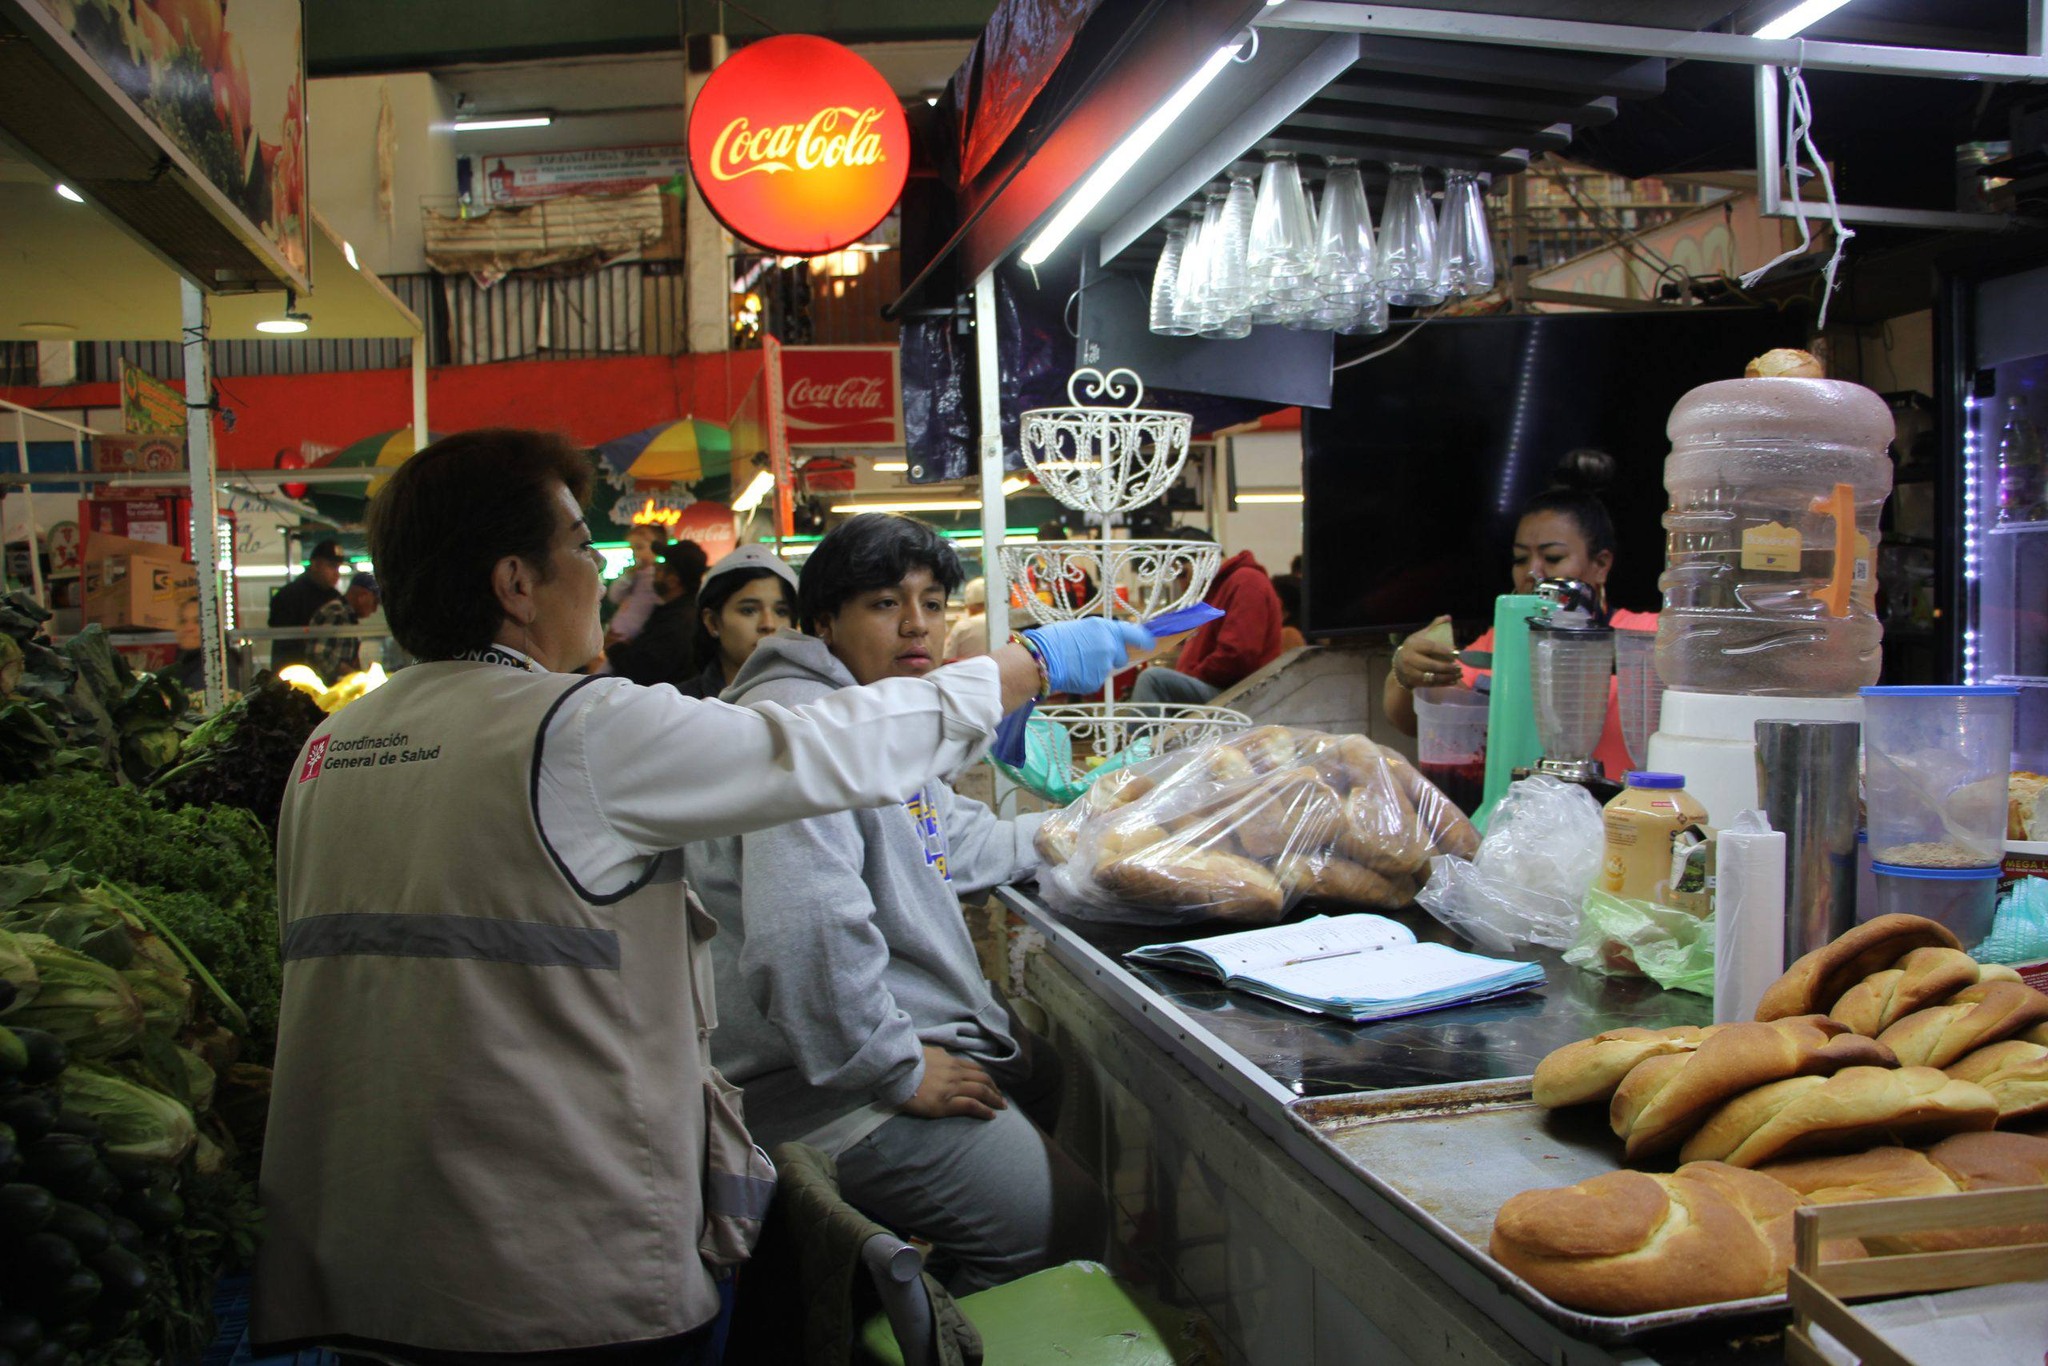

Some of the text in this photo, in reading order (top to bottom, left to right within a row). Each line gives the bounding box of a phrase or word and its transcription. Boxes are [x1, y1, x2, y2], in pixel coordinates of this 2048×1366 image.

[710, 107, 885, 181] Coca-Cola
[787, 376, 885, 410] Coca-Cola
[329, 733, 409, 752] Coordinación
[324, 745, 441, 769] General de Salud
[2005, 860, 2038, 870] MEGA
